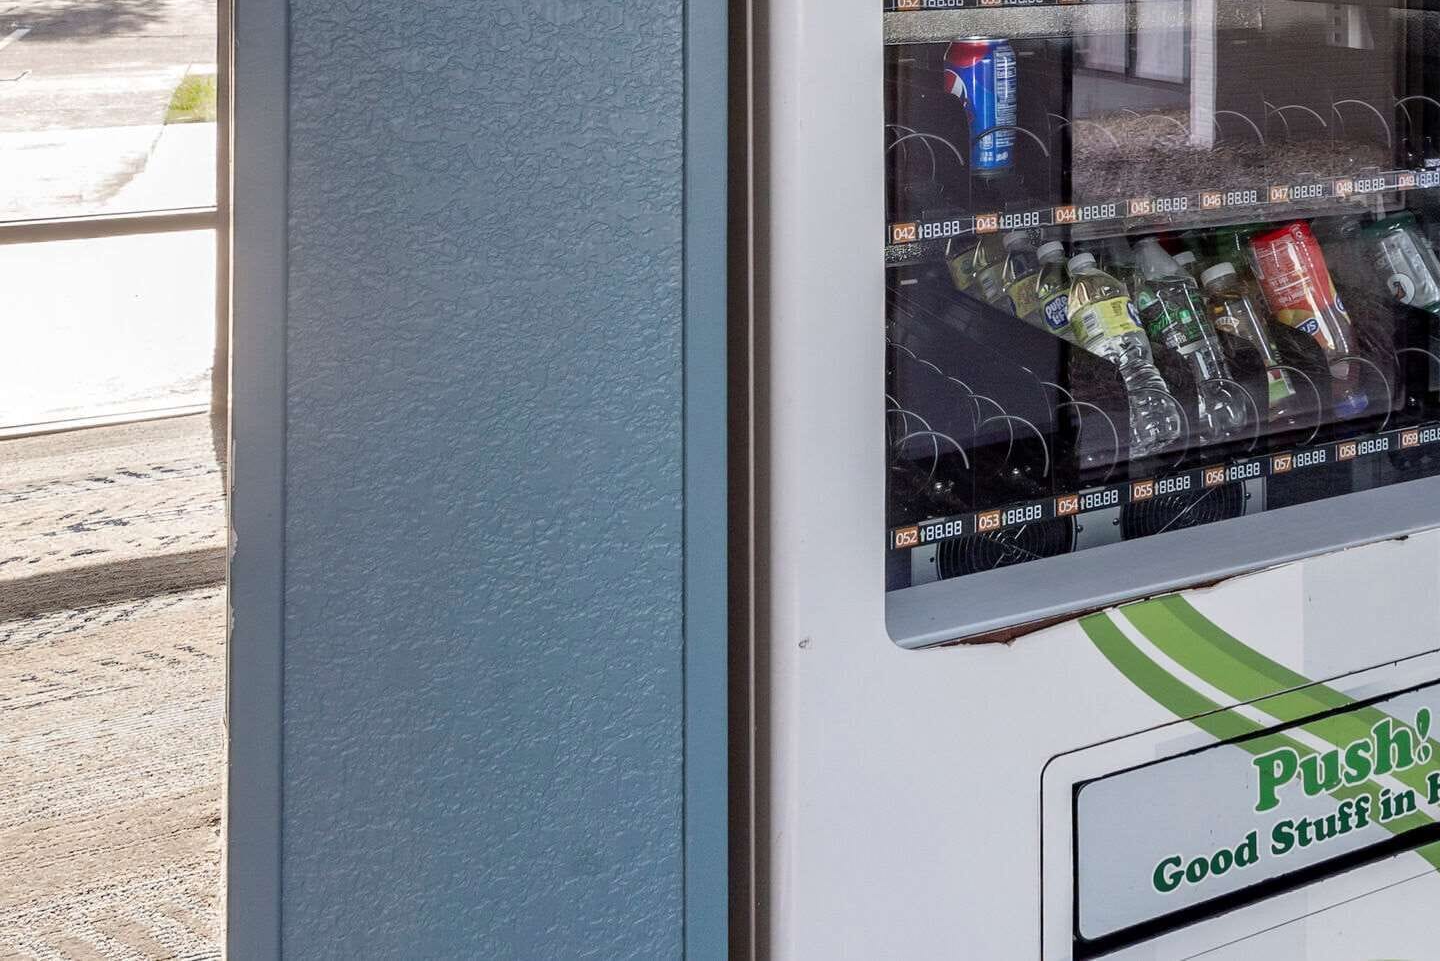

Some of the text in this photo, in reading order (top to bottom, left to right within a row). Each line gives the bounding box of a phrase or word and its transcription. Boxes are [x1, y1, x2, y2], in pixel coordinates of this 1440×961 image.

[1047, 295, 1068, 319] PURE
[1252, 706, 1434, 812] Push!
[1152, 831, 1259, 894] Good
[1269, 793, 1371, 857] Stuff
[1379, 786, 1417, 823] in
